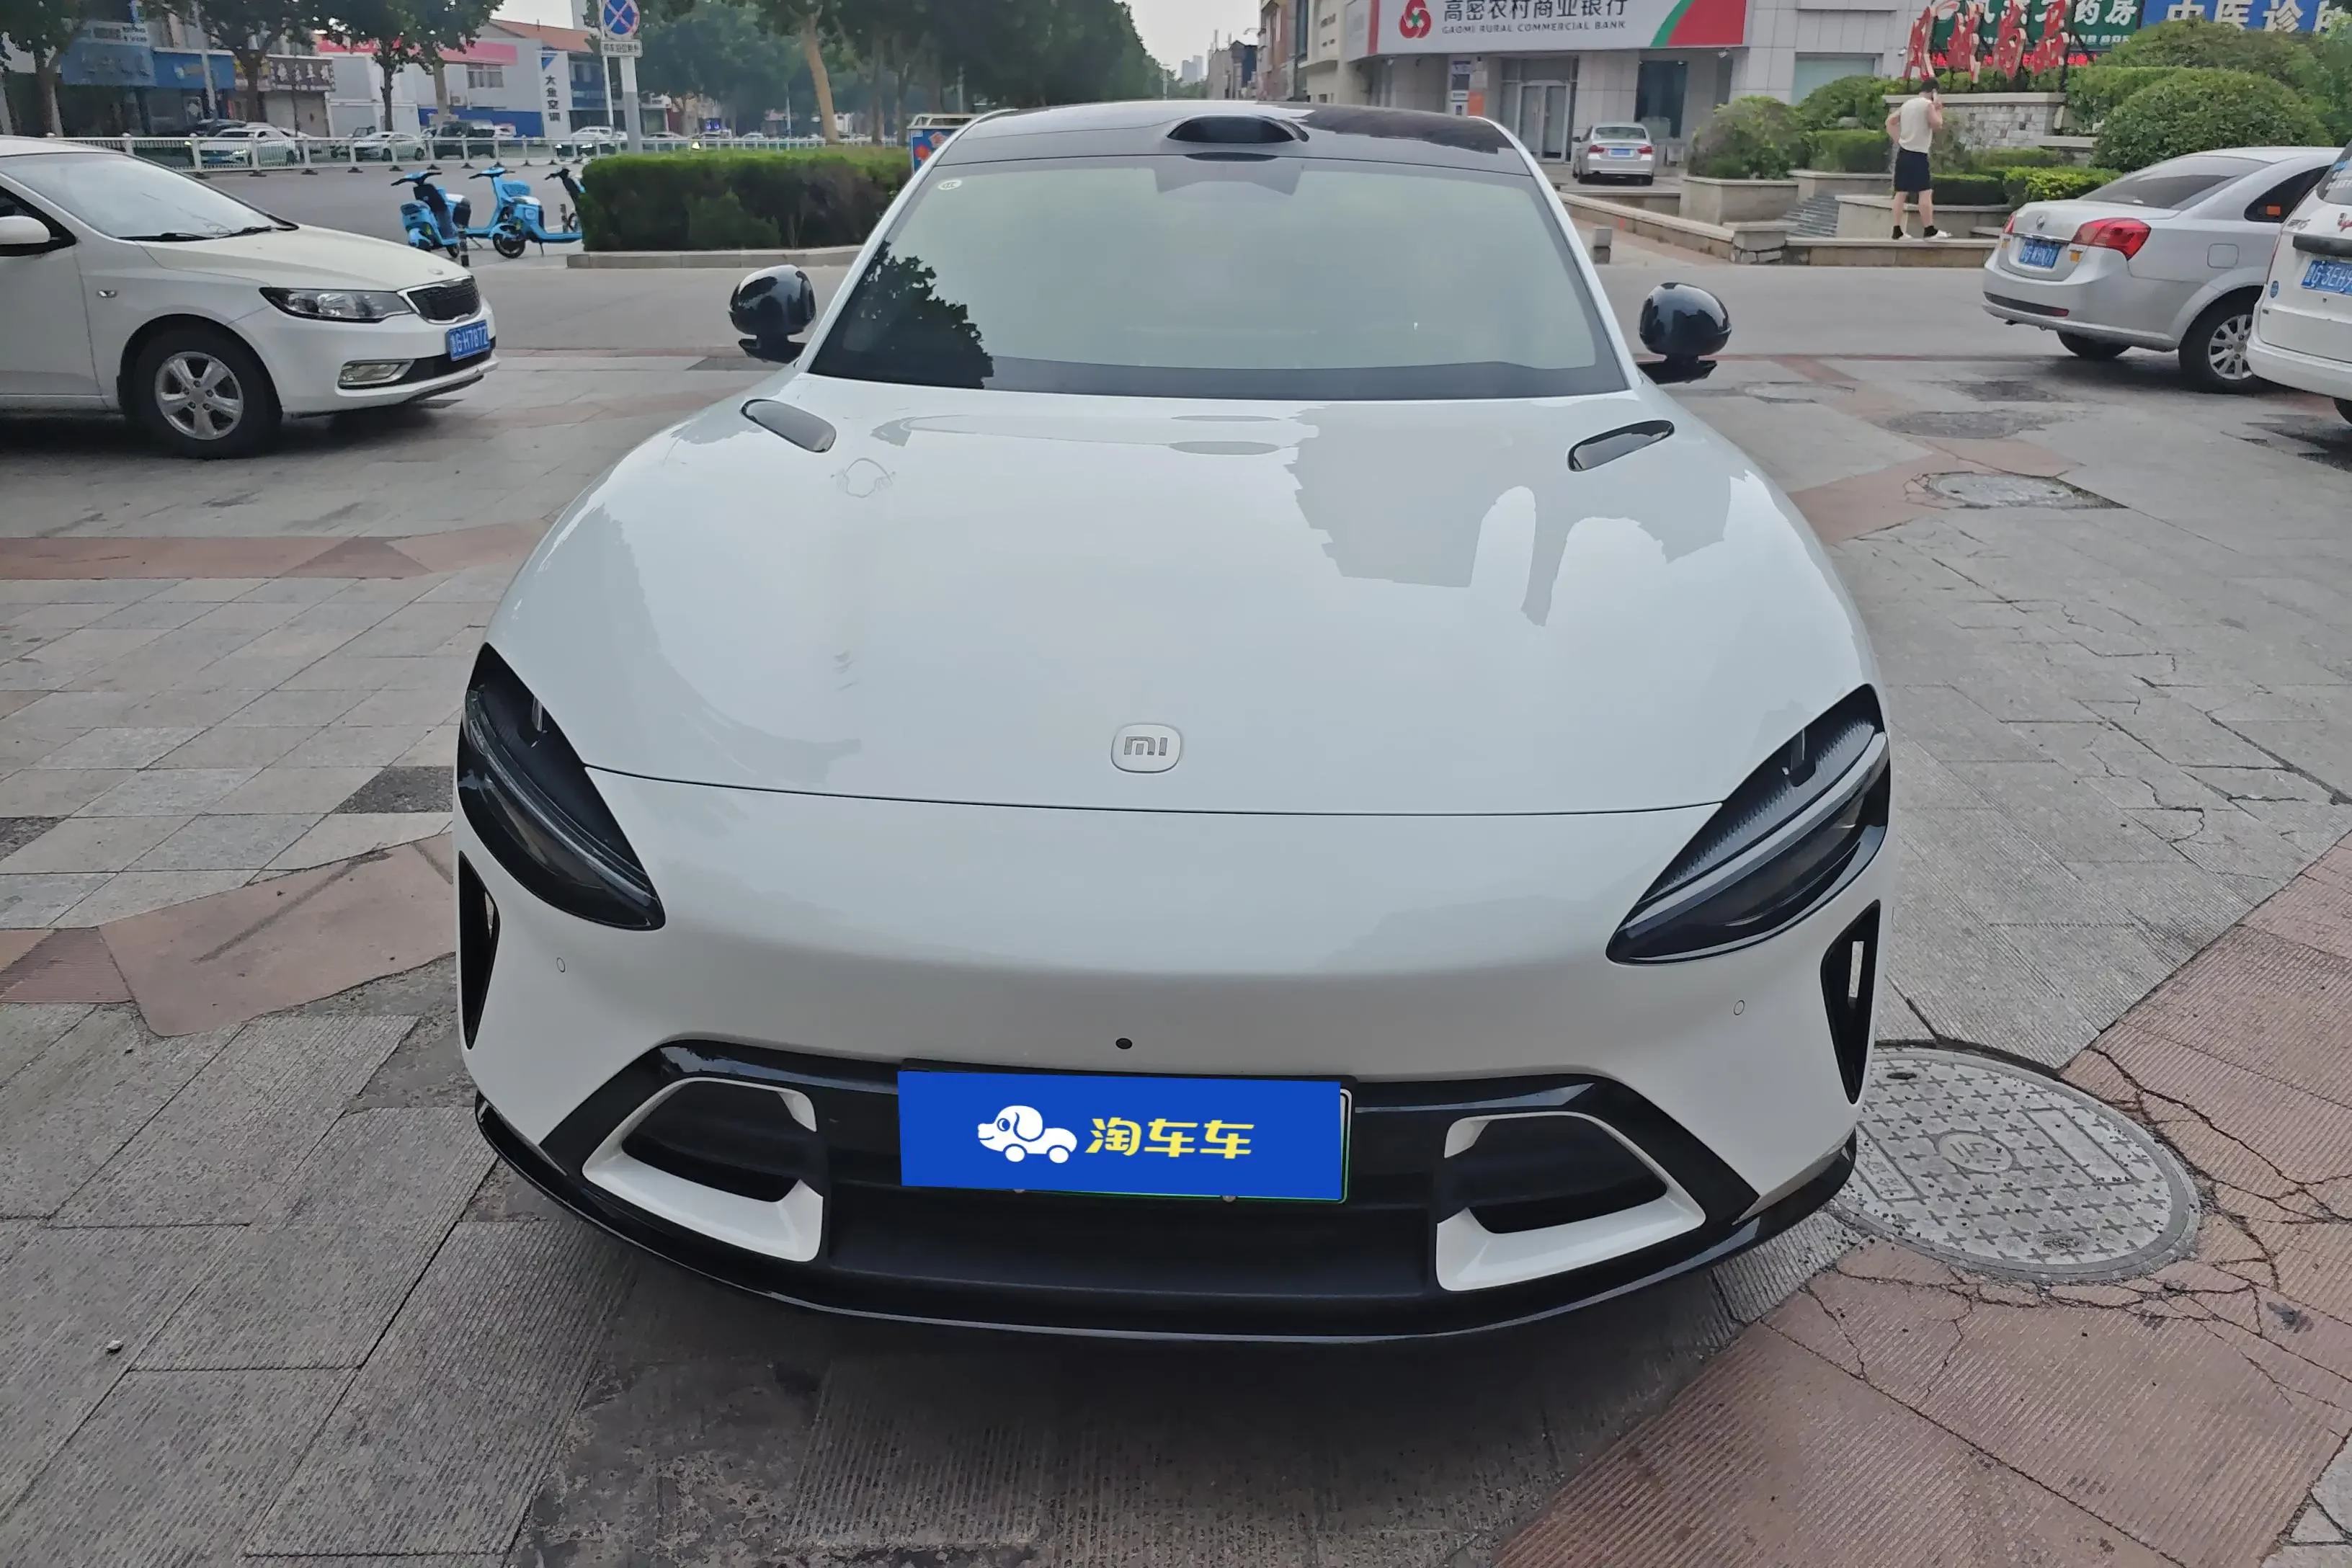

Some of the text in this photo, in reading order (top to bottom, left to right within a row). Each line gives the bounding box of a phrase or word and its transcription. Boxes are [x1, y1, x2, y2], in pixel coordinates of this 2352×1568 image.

[1441, 20, 1626, 34] GAOMI RURAL COMMERCIAL BANK
